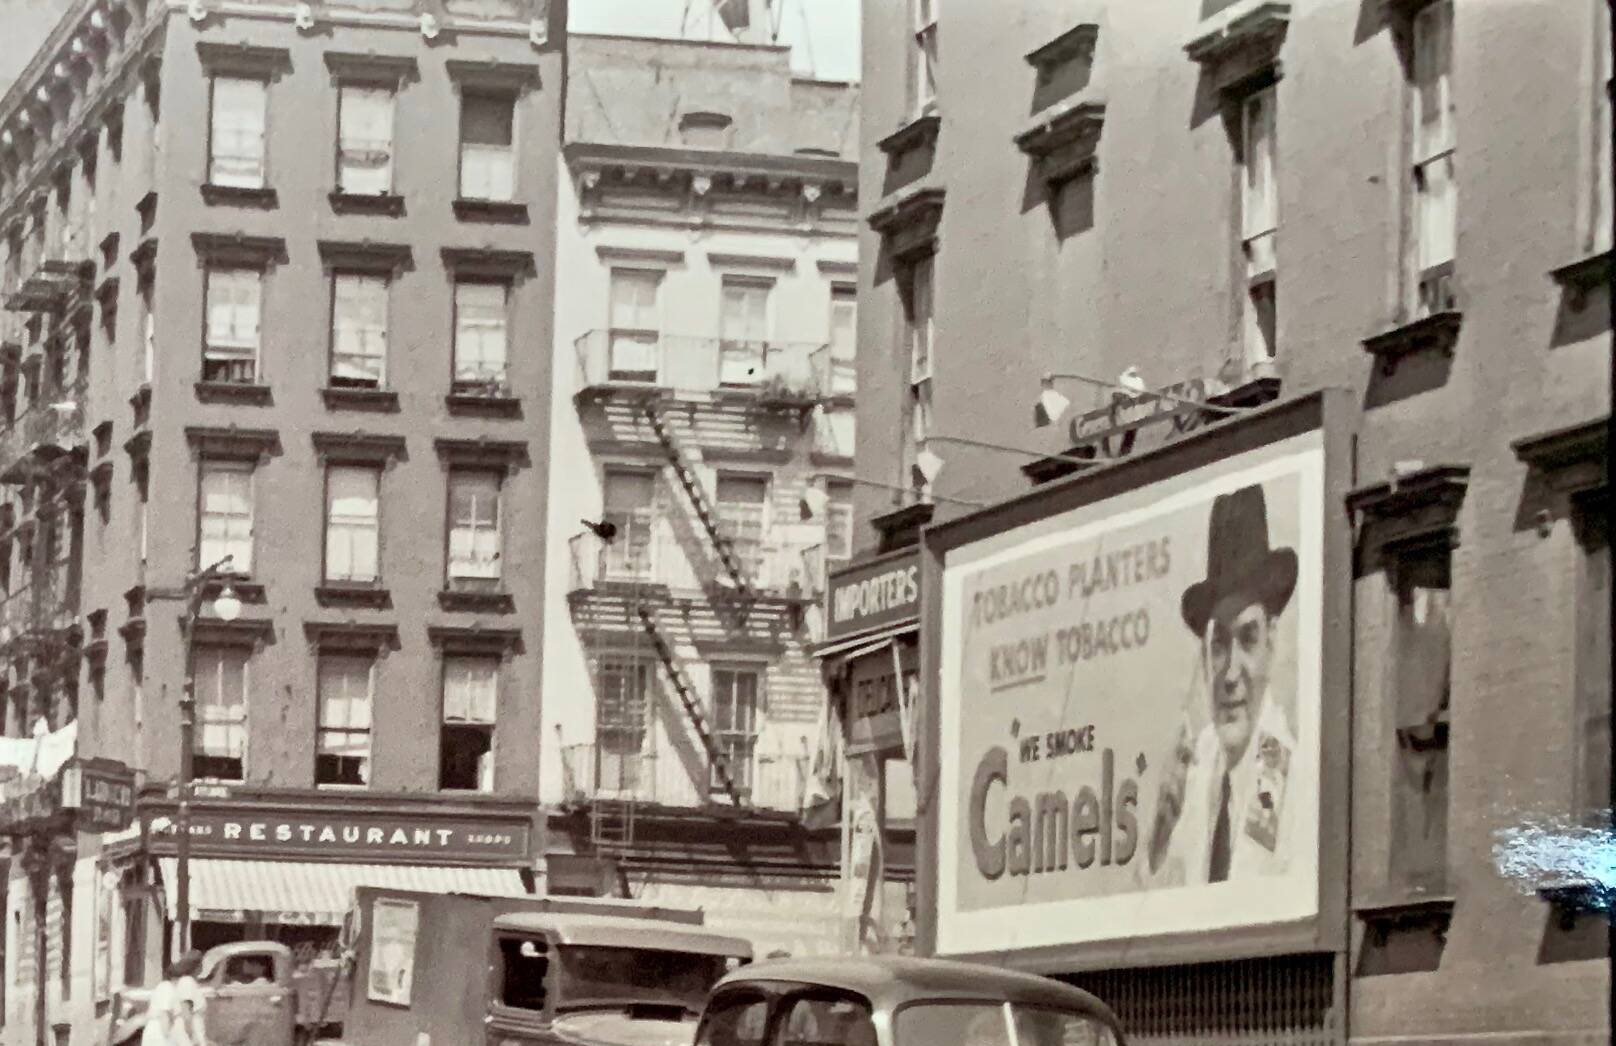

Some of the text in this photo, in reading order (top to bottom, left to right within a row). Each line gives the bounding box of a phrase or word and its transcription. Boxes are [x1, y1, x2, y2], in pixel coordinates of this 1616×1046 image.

[834, 565, 918, 622] IMPORTERS
[973, 536, 1171, 628] TOBACCO PLANTERS
[989, 607, 1150, 680] KNOW TOBACCO
[1045, 724, 1095, 759] SMOKE
[223, 822, 453, 847] RESTAURANT
